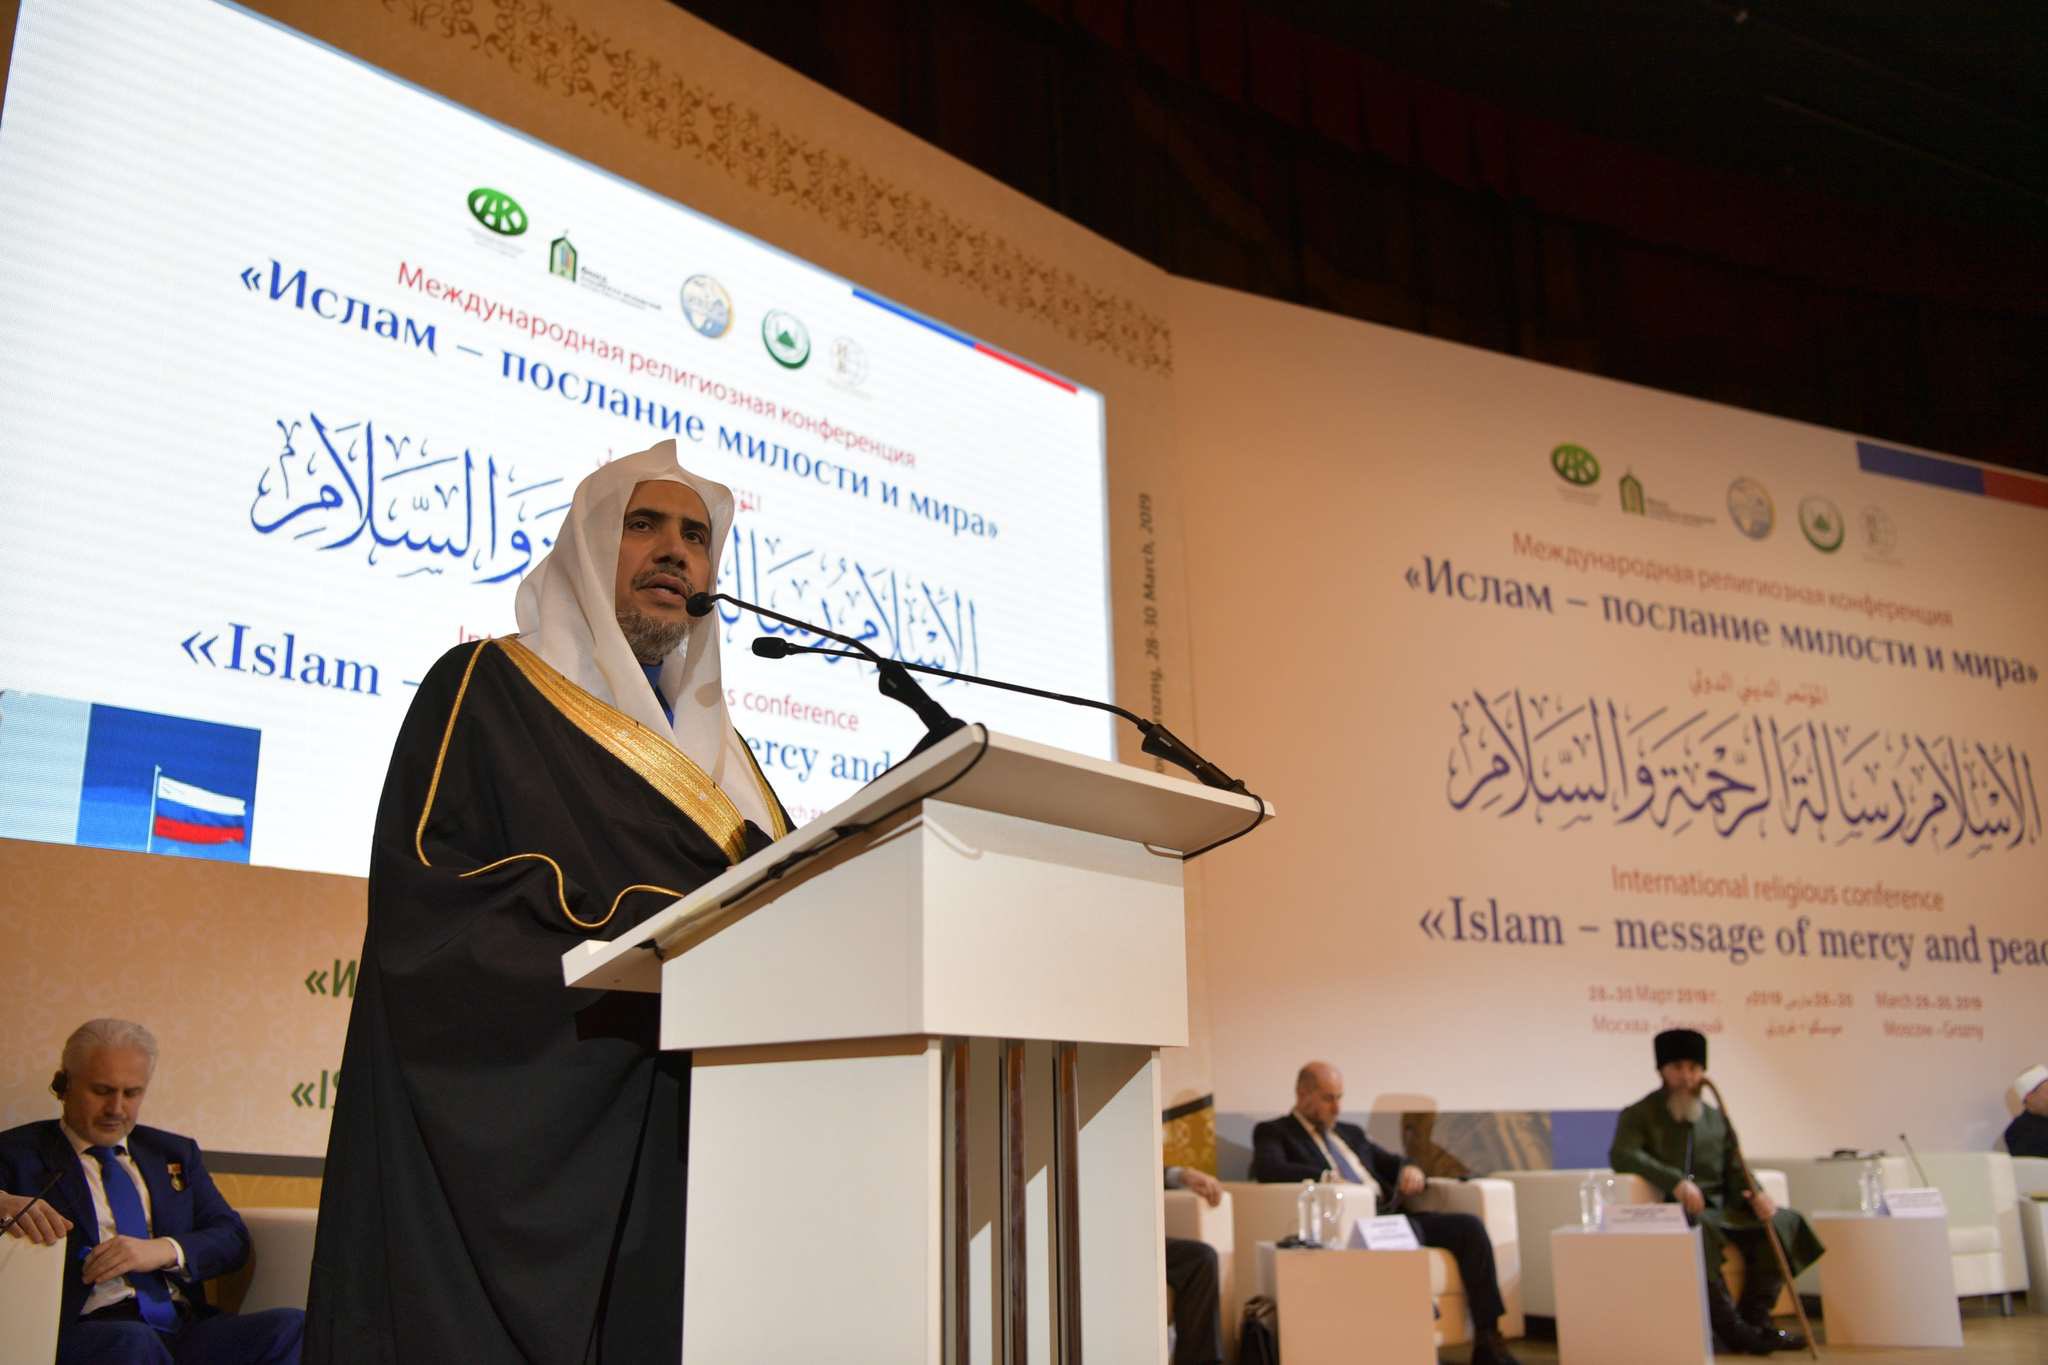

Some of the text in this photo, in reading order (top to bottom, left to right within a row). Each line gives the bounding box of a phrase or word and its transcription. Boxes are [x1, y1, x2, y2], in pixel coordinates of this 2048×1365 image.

[398, 261, 624, 364] Международная
[629, 351, 777, 418] религиозная
[782, 408, 916, 469] конференция
[241, 257, 437, 355] «Ислам
[502, 349, 705, 442] послание
[718, 423, 870, 500] милости
[880, 478, 900, 508] и
[910, 489, 999, 540] мира»
[1139, 493, 1153, 533] 2019
[1512, 531, 1694, 584] Международная
[1405, 555, 1554, 615] «Ислам
[1601, 594, 1770, 647] послание
[1780, 622, 1918, 670] милости
[1925, 646, 1945, 672] и
[1951, 649, 2039, 690] мира»
[180, 621, 383, 697] «Islam
[743, 691, 860, 732] conference
[744, 735, 818, 783] ercy
[1611, 863, 1944, 913] International religious conference
[1418, 896, 1564, 946] «Islam
[1614, 914, 1765, 966] message
[1776, 915, 1811, 957] of
[1818, 926, 1915, 971] mercy
[1926, 924, 1983, 964] and
[1987, 936, 2048, 975] peac
